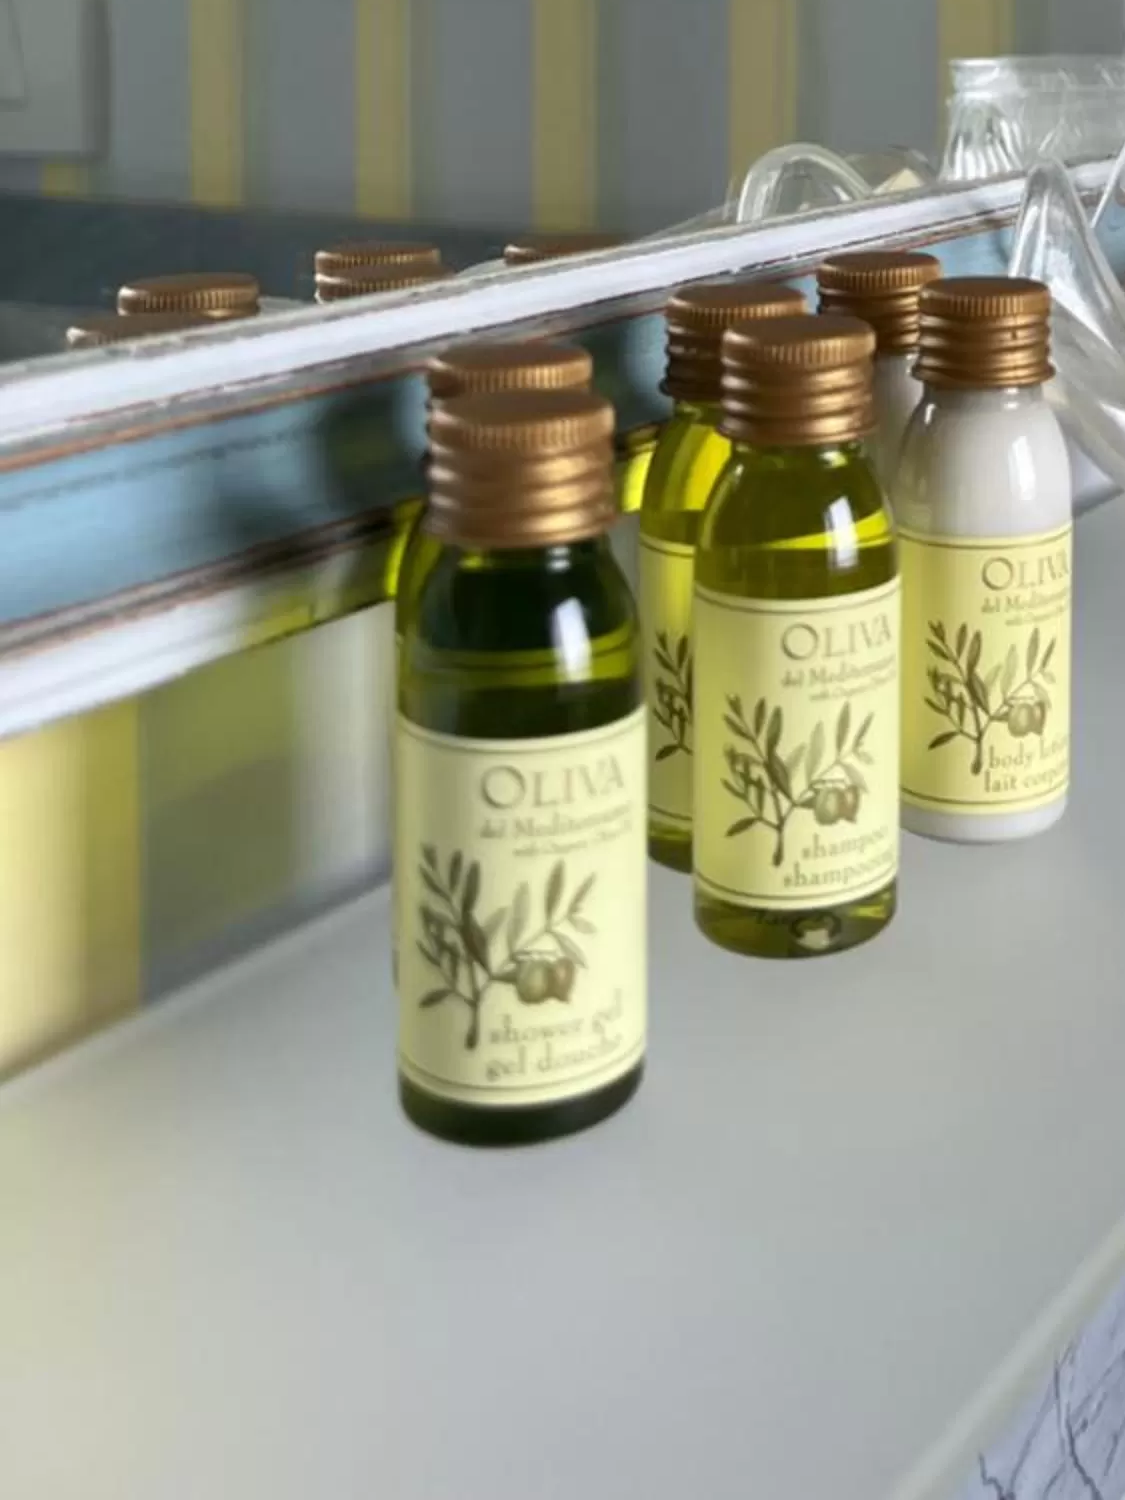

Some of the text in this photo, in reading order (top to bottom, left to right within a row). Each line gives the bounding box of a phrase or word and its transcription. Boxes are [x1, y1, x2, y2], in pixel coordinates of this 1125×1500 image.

[981, 548, 1070, 592] OLIVA
[780, 612, 893, 661] OLIVA
[987, 744, 1033, 770] body
[479, 754, 626, 811] OLIVA
[984, 767, 1018, 794] lait
[489, 1013, 586, 1045] shower
[485, 1043, 528, 1084] gel
